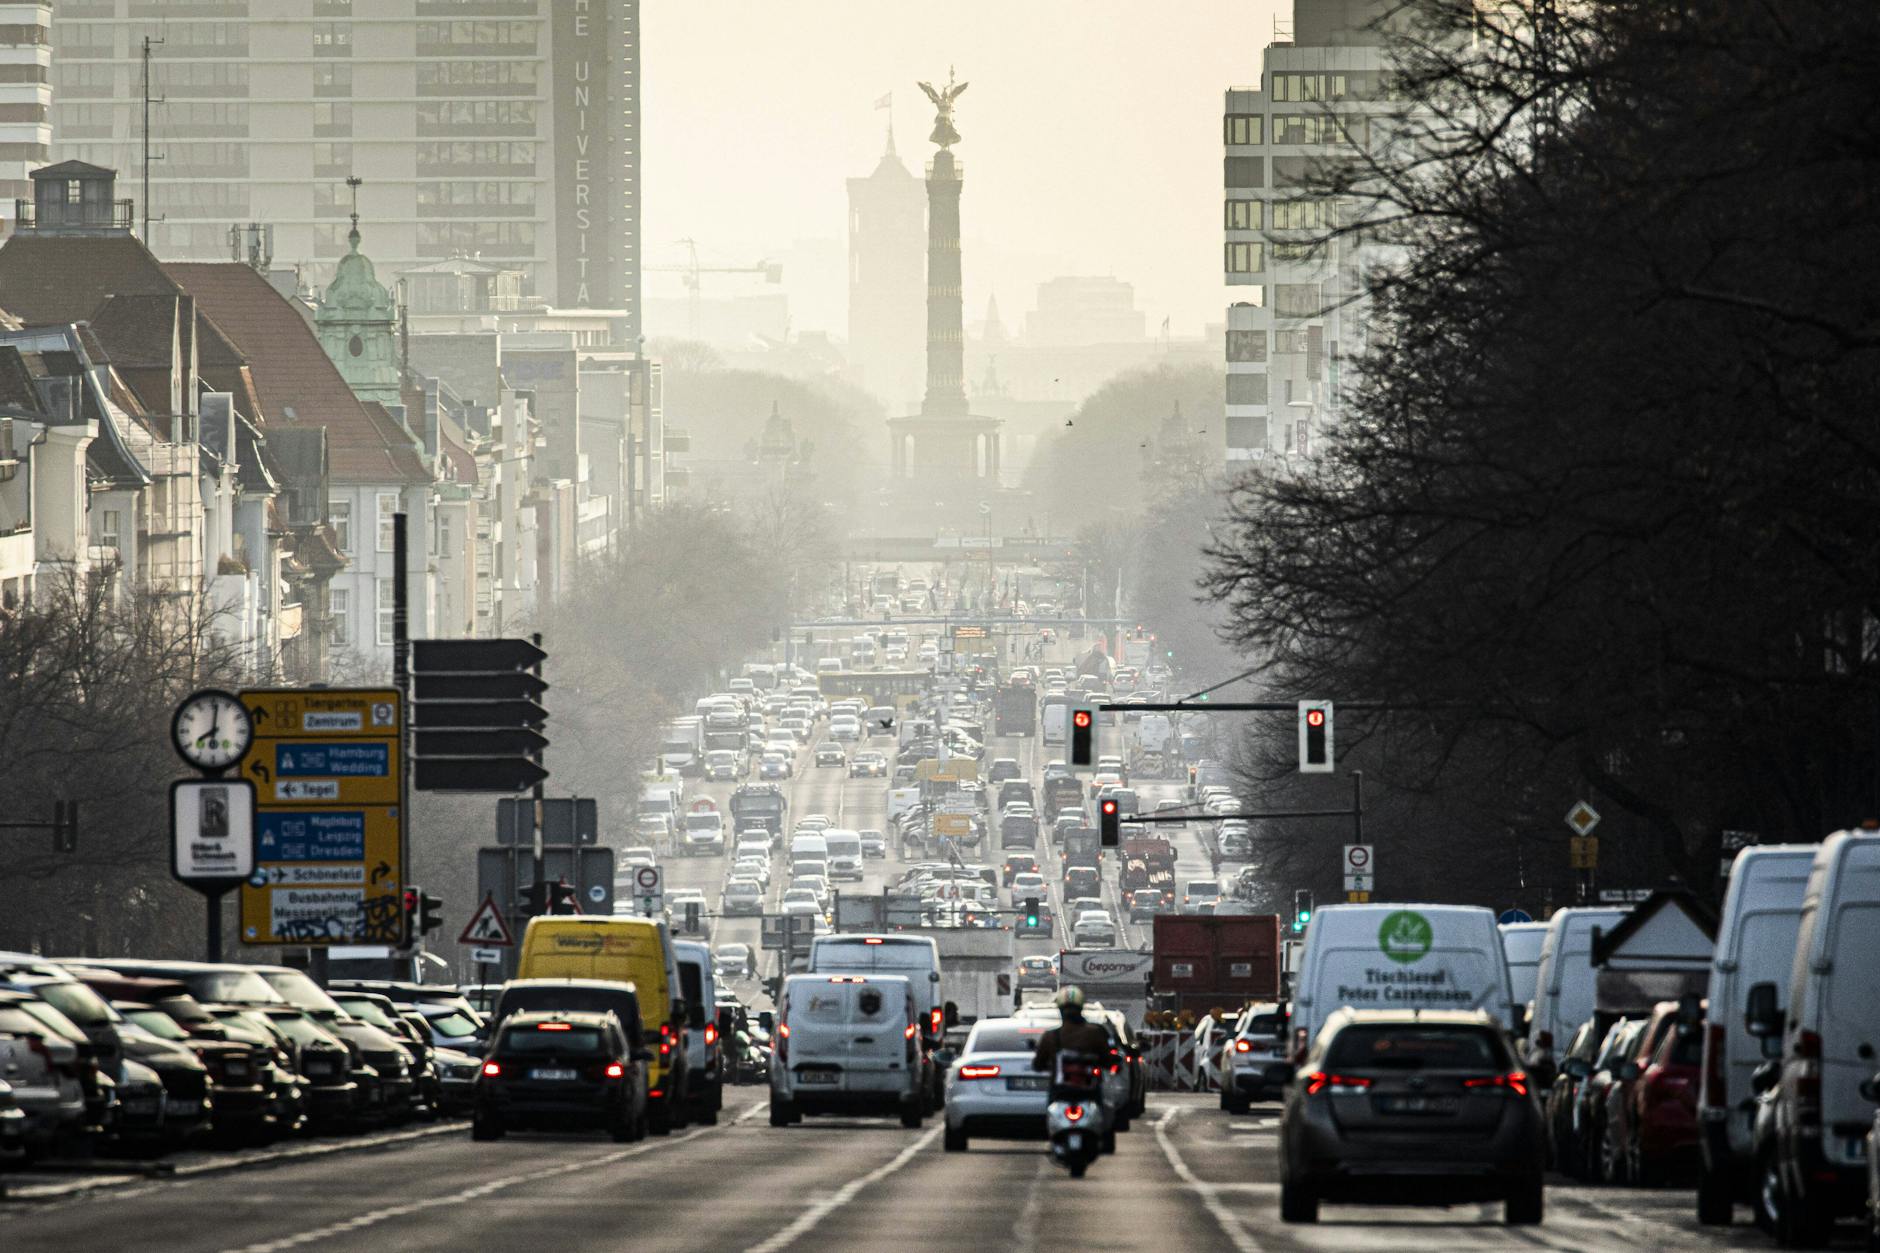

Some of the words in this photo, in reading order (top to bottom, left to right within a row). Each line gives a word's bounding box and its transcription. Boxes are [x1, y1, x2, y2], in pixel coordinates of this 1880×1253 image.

[306, 715, 358, 728] Zentrum
[328, 747, 385, 761] Hamburg
[330, 761, 384, 776] Wedding
[302, 784, 336, 798] Tegel
[318, 831, 362, 845] Leipzig
[310, 845, 362, 857] Dresden
[293, 868, 362, 881] Schönefeld
[288, 891, 362, 904] Busbahnhof
[1337, 984, 1378, 1001] Peter
